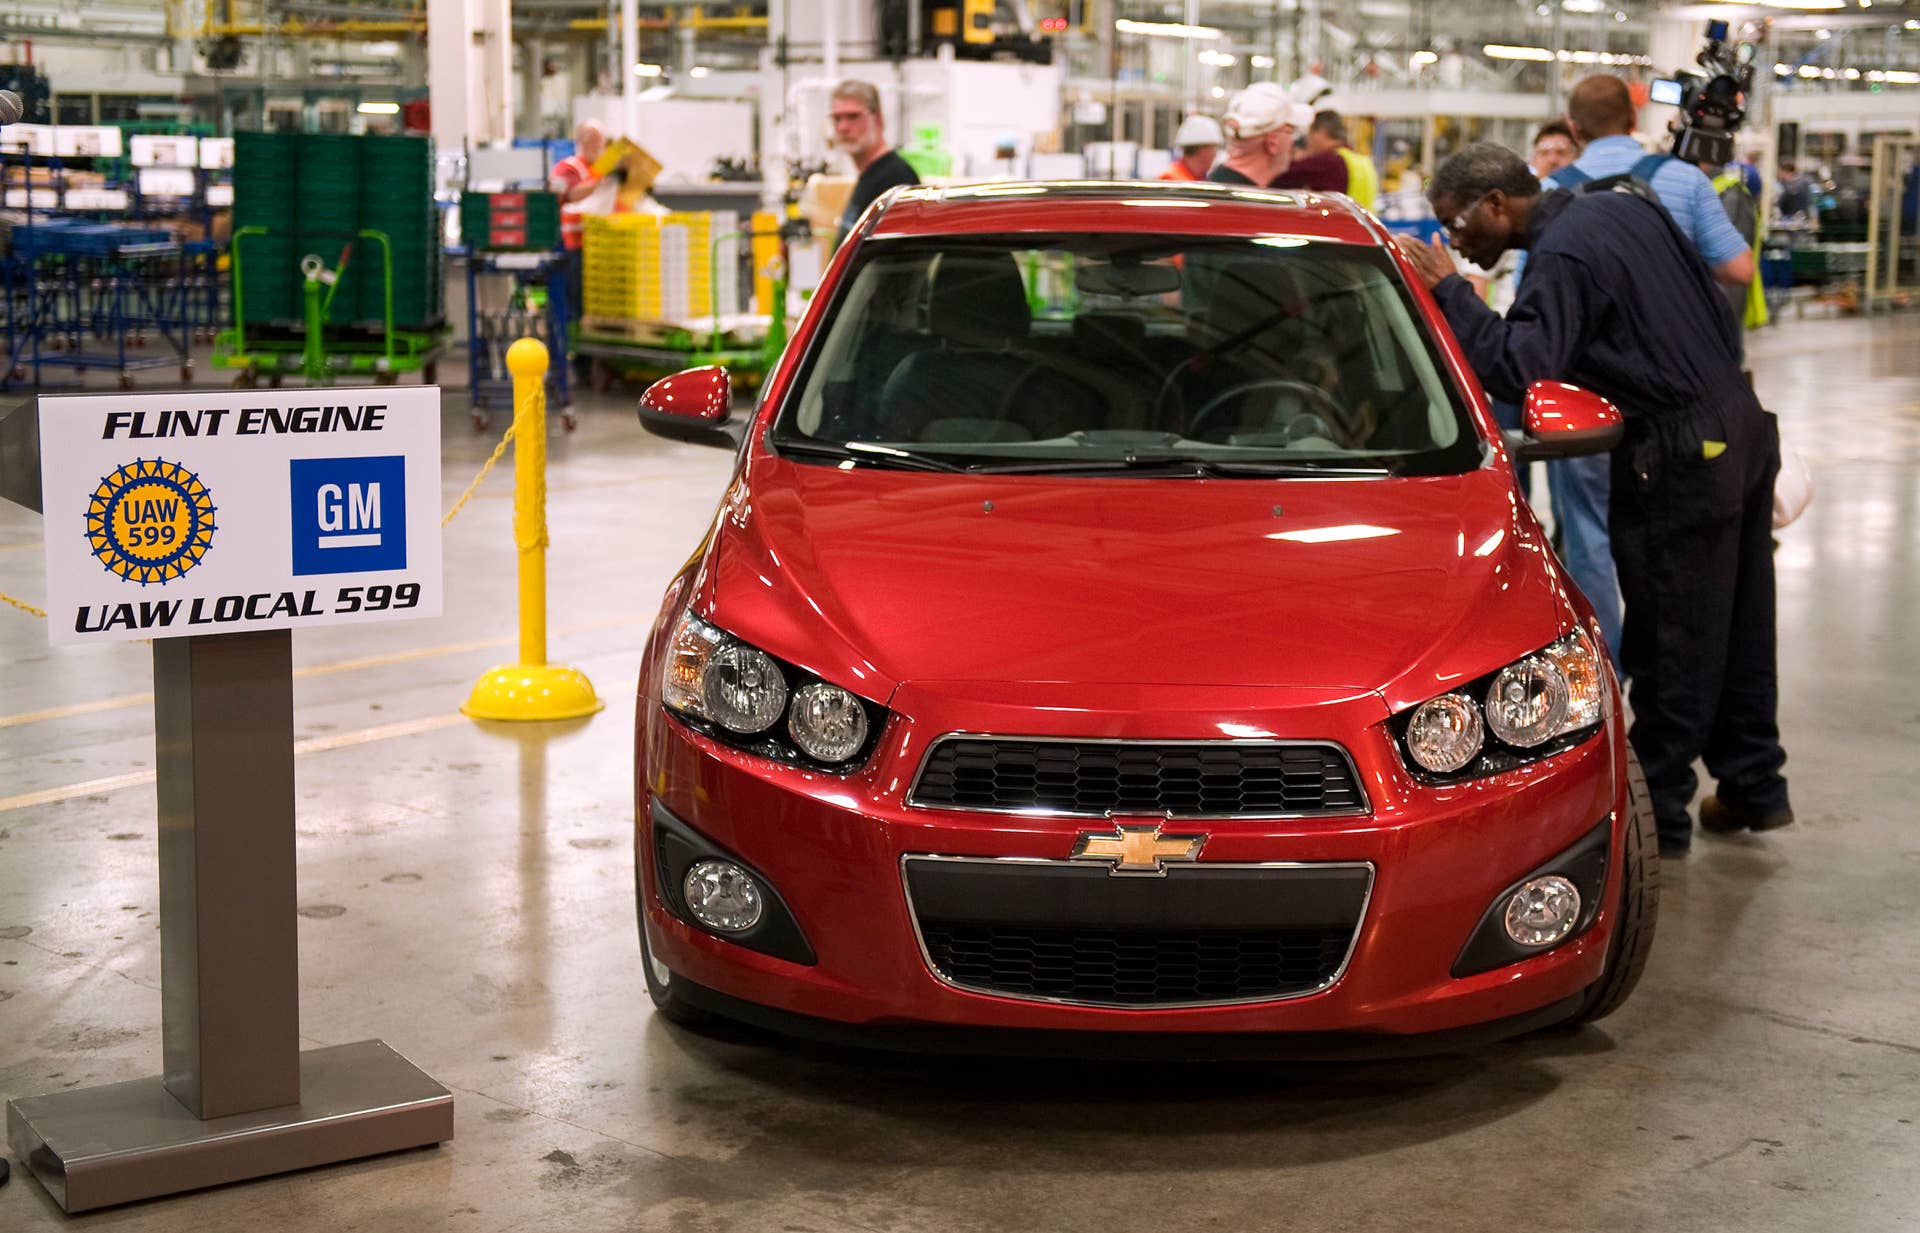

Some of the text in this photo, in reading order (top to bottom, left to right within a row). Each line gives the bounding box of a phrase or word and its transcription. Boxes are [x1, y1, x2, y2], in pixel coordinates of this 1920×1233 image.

[102, 405, 387, 439] FLINT ENGINE
[123, 499, 179, 525] UAW
[317, 482, 381, 531] GM
[128, 526, 176, 547] 599
[75, 583, 421, 633] UAW LOCAL 599
